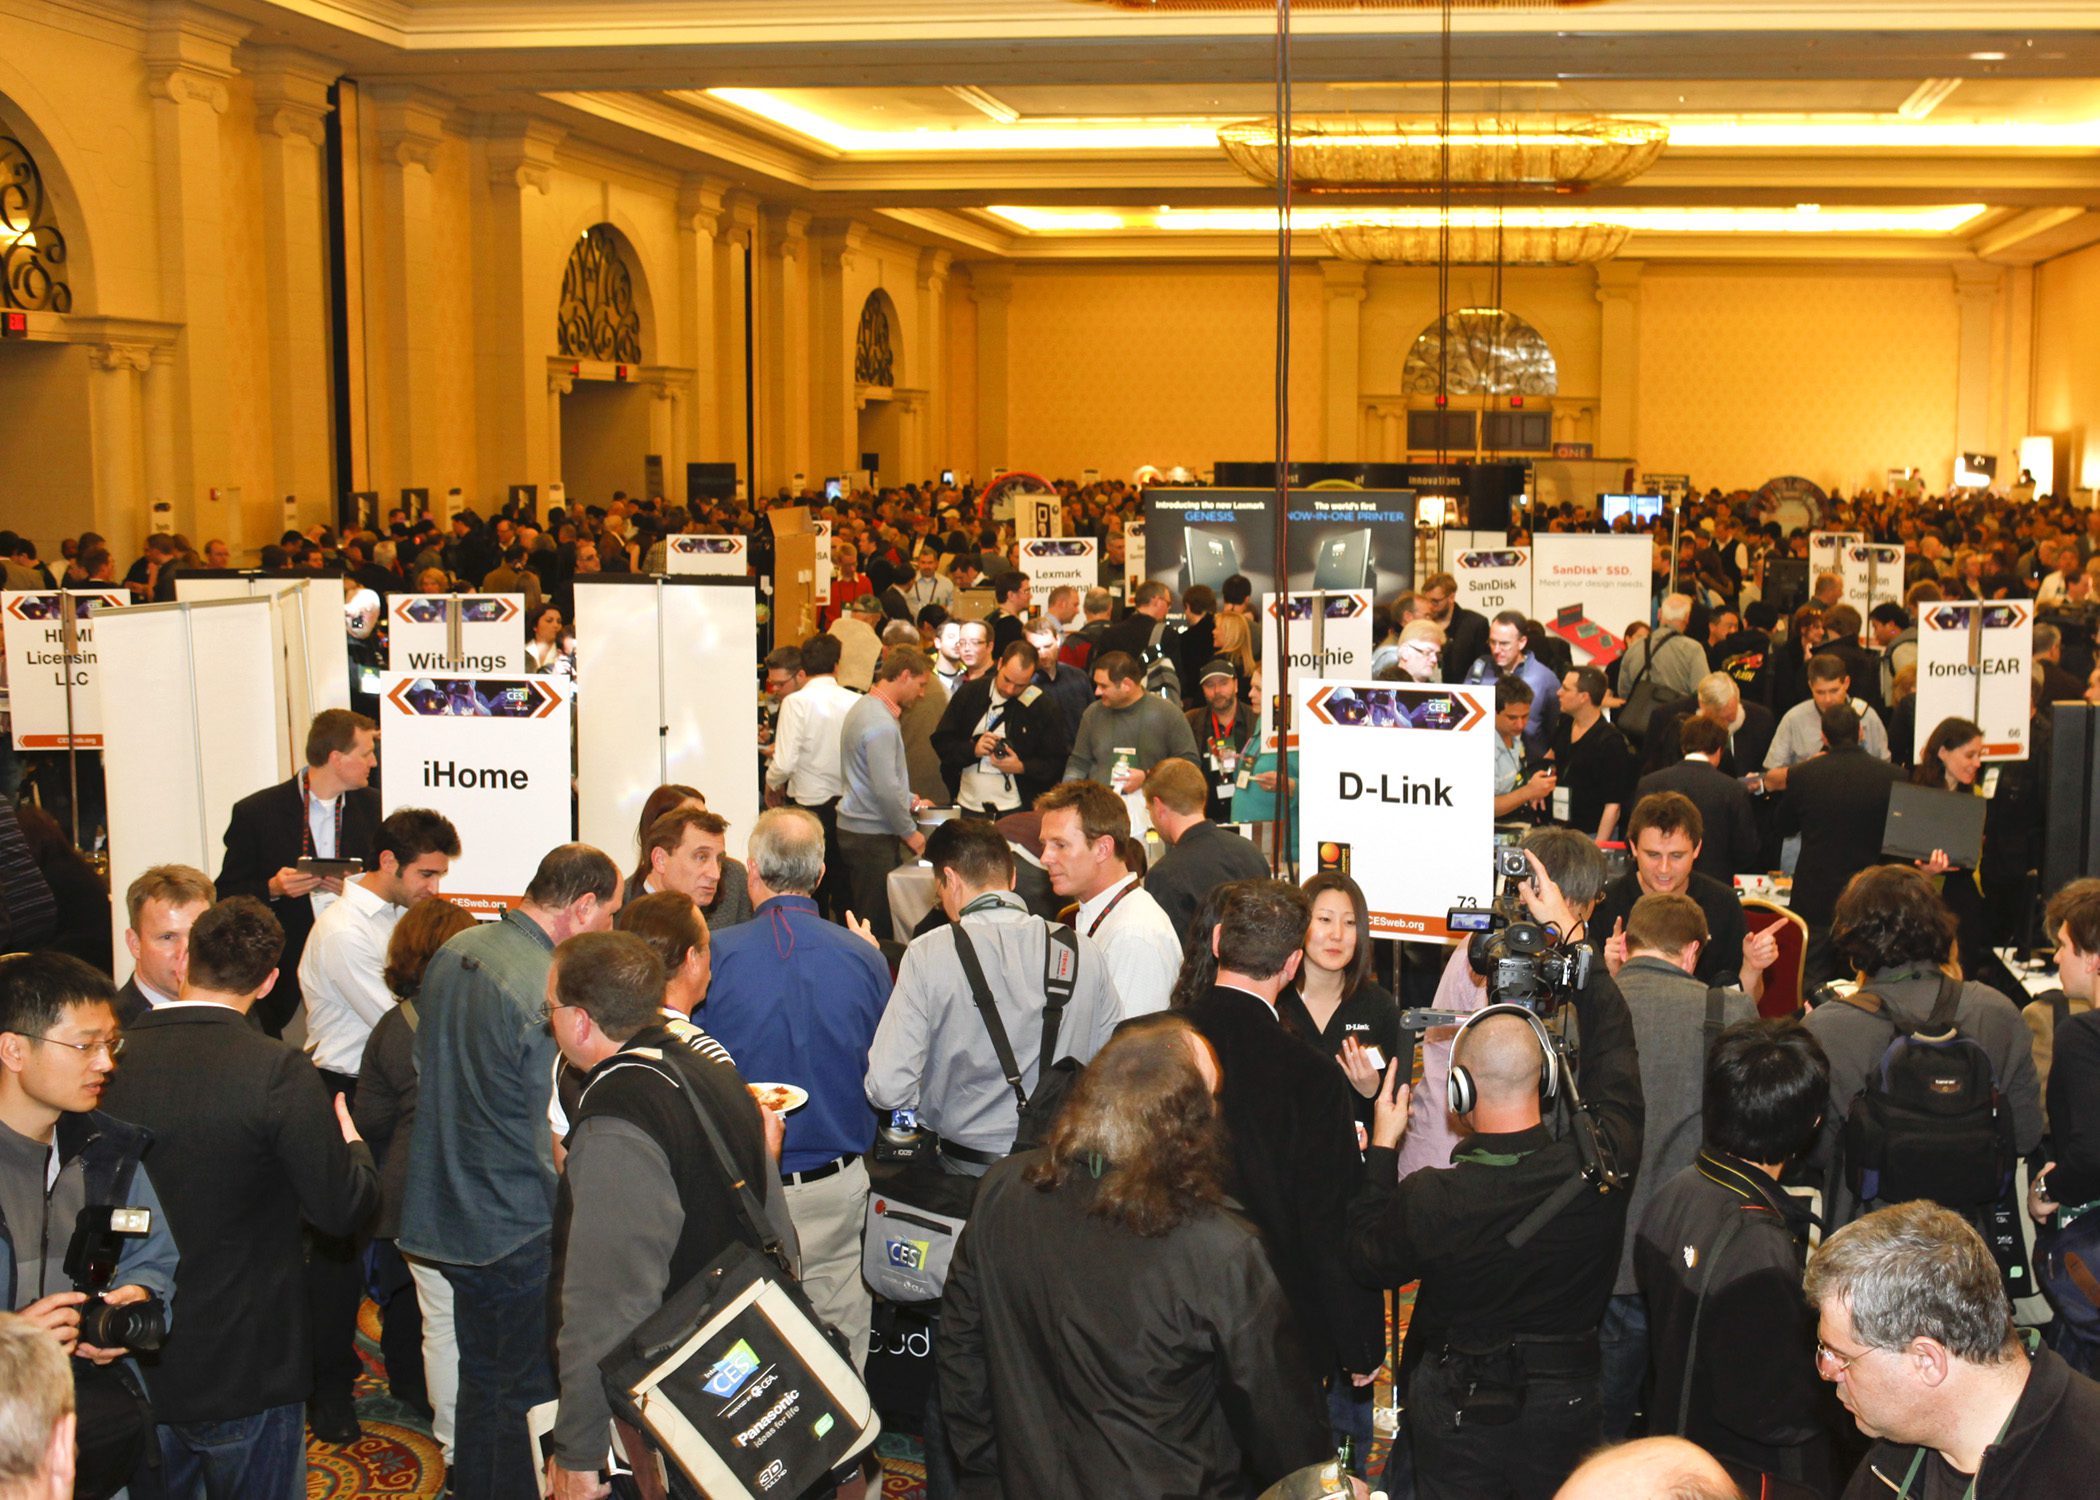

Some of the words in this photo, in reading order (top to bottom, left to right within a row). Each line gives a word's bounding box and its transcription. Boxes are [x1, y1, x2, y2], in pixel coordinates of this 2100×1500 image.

[1201, 500, 1214, 509] the
[1215, 501, 1232, 509] new
[1314, 501, 1329, 510] The
[1330, 501, 1359, 511] world's
[1360, 501, 1376, 511] first
[1035, 569, 1082, 579] Lexmark
[1469, 580, 1516, 591] SanDisk
[1539, 579, 1560, 587] Meet
[1563, 580, 1583, 589] your
[1585, 578, 1614, 589] design
[1482, 595, 1504, 607] LTD
[45, 629, 92, 643] HMI
[27, 651, 98, 665] Licensin
[55, 671, 89, 686] LC
[506, 691, 524, 701] CES
[1428, 703, 1446, 712] CES
[2008, 728, 2021, 738] 66
[423, 760, 529, 790] iHome
[1339, 771, 1454, 807] D-Link
[1456, 895, 1478, 909] 73
[1345, 1023, 1370, 1031] D-Link
[889, 1242, 919, 1268] CES
[713, 1351, 751, 1393] CES
[737, 1389, 800, 1447] Panasonic
[753, 1427, 776, 1449] ideas
[773, 1415, 788, 1429] for
[786, 1404, 801, 1420] life
[759, 1459, 783, 1487] 3D
